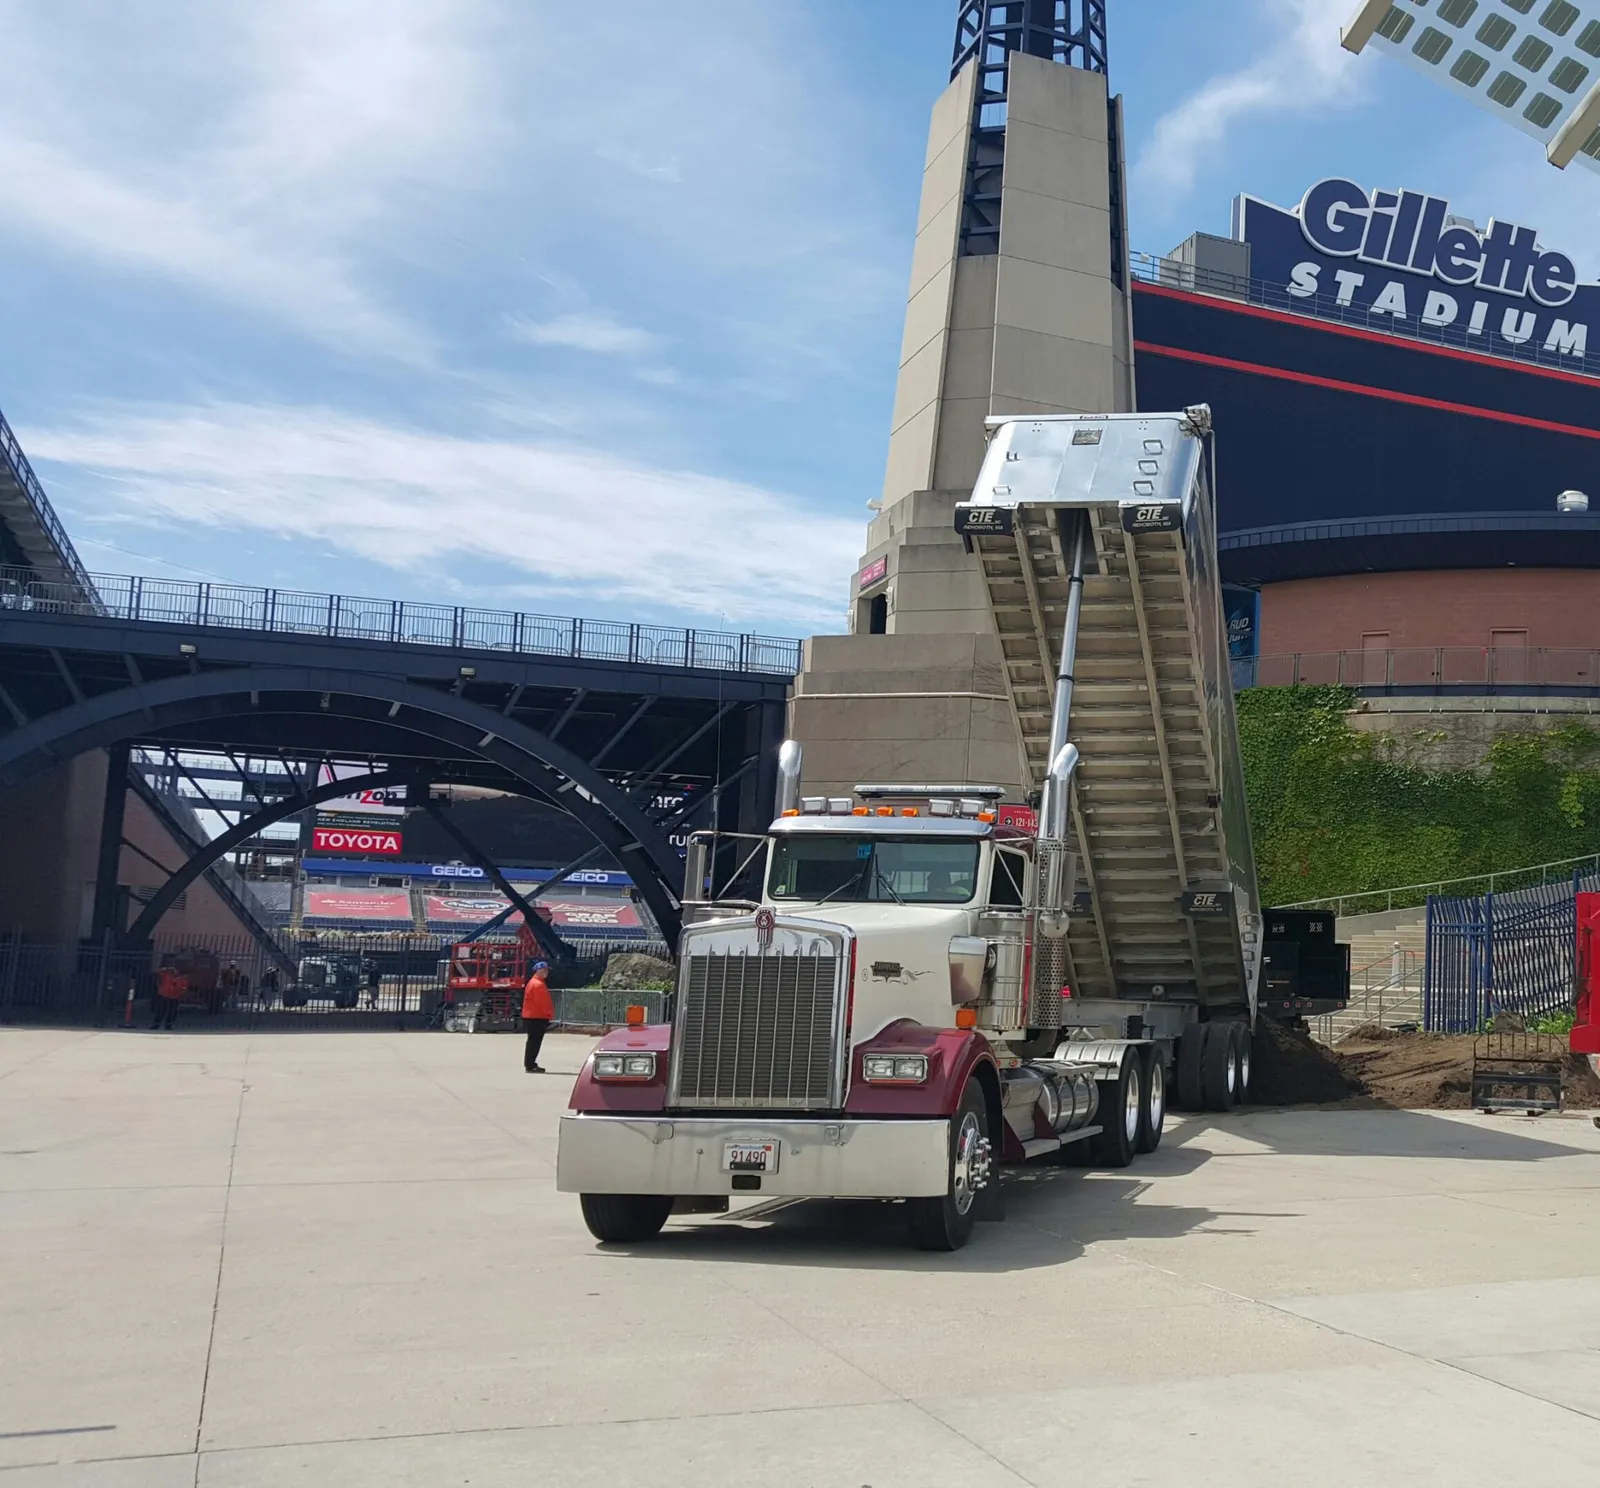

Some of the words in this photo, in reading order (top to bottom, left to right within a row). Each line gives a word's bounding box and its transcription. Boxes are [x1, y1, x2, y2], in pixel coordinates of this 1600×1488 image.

[1300, 177, 1578, 307] Gillette
[1286, 261, 1588, 358] STADIUM
[968, 508, 996, 523] CTE
[1136, 506, 1164, 520] CTE
[316, 832, 398, 850] TOYOTA
[432, 866, 484, 877] GEICO
[1193, 893, 1217, 905] CTE
[731, 1150, 767, 1163] 91490
